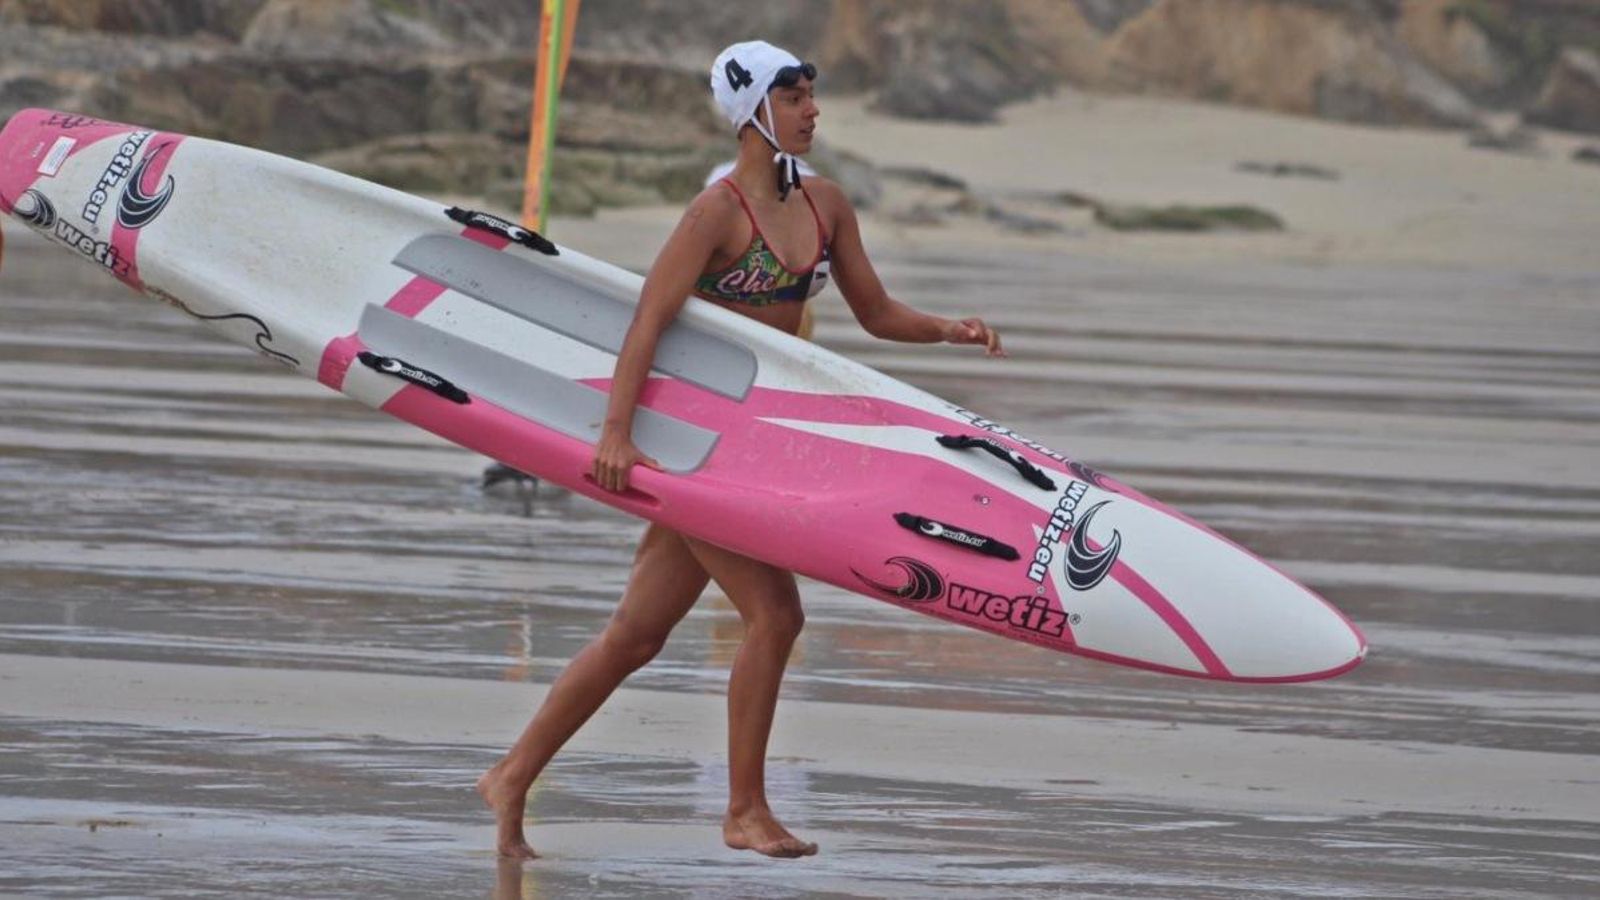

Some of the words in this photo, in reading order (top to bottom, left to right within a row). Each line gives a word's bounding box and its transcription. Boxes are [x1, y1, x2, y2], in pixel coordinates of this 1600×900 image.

[725, 58, 753, 92] 4
[82, 130, 150, 224] wetiz.eu
[54, 218, 132, 277] wetiz
[1027, 480, 1089, 584] wetiz.eu
[947, 582, 1069, 638] wetiz
